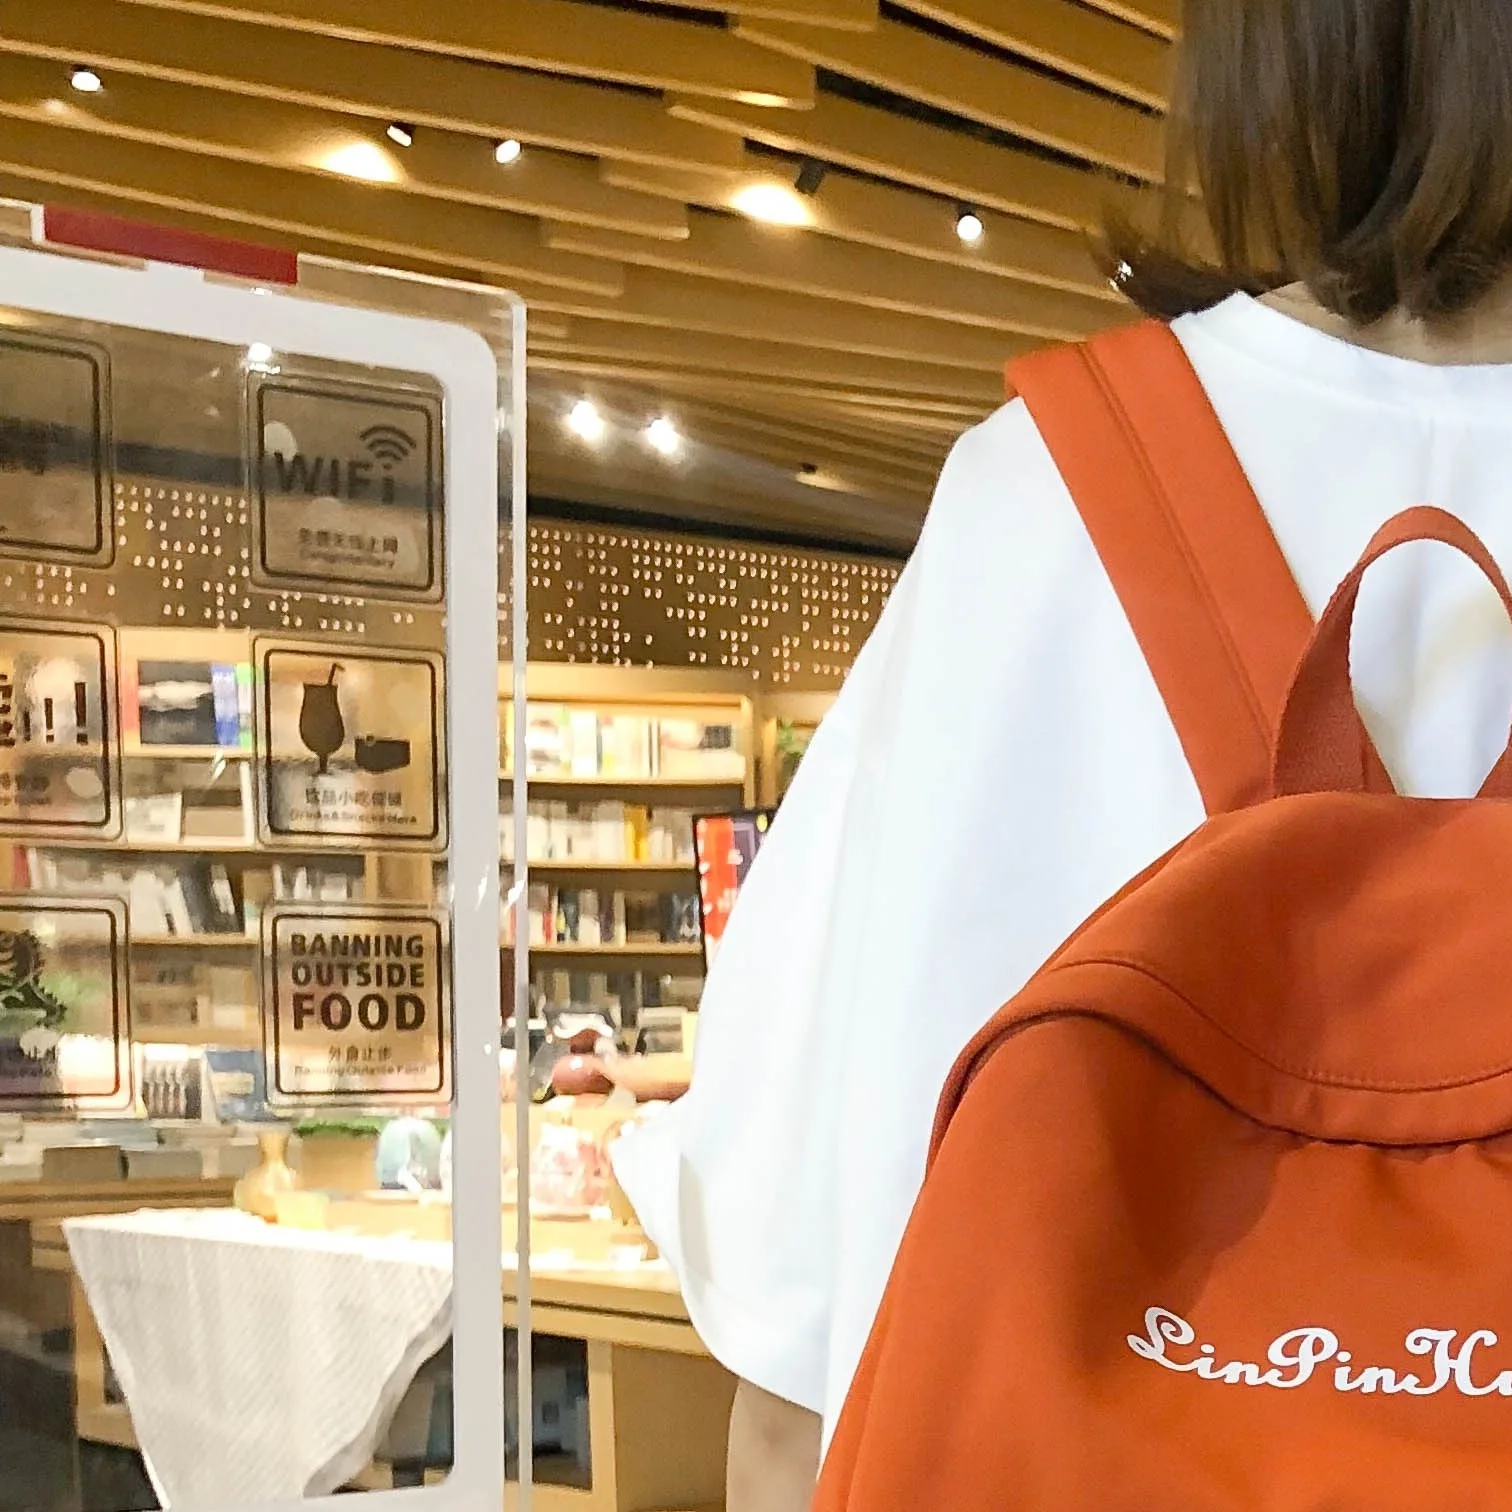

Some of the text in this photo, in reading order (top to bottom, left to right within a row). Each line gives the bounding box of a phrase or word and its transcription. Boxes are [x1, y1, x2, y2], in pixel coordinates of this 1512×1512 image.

[291, 933, 424, 960] BANNING
[291, 962, 425, 989] OUTSIDE
[292, 992, 426, 1032] FOOD
